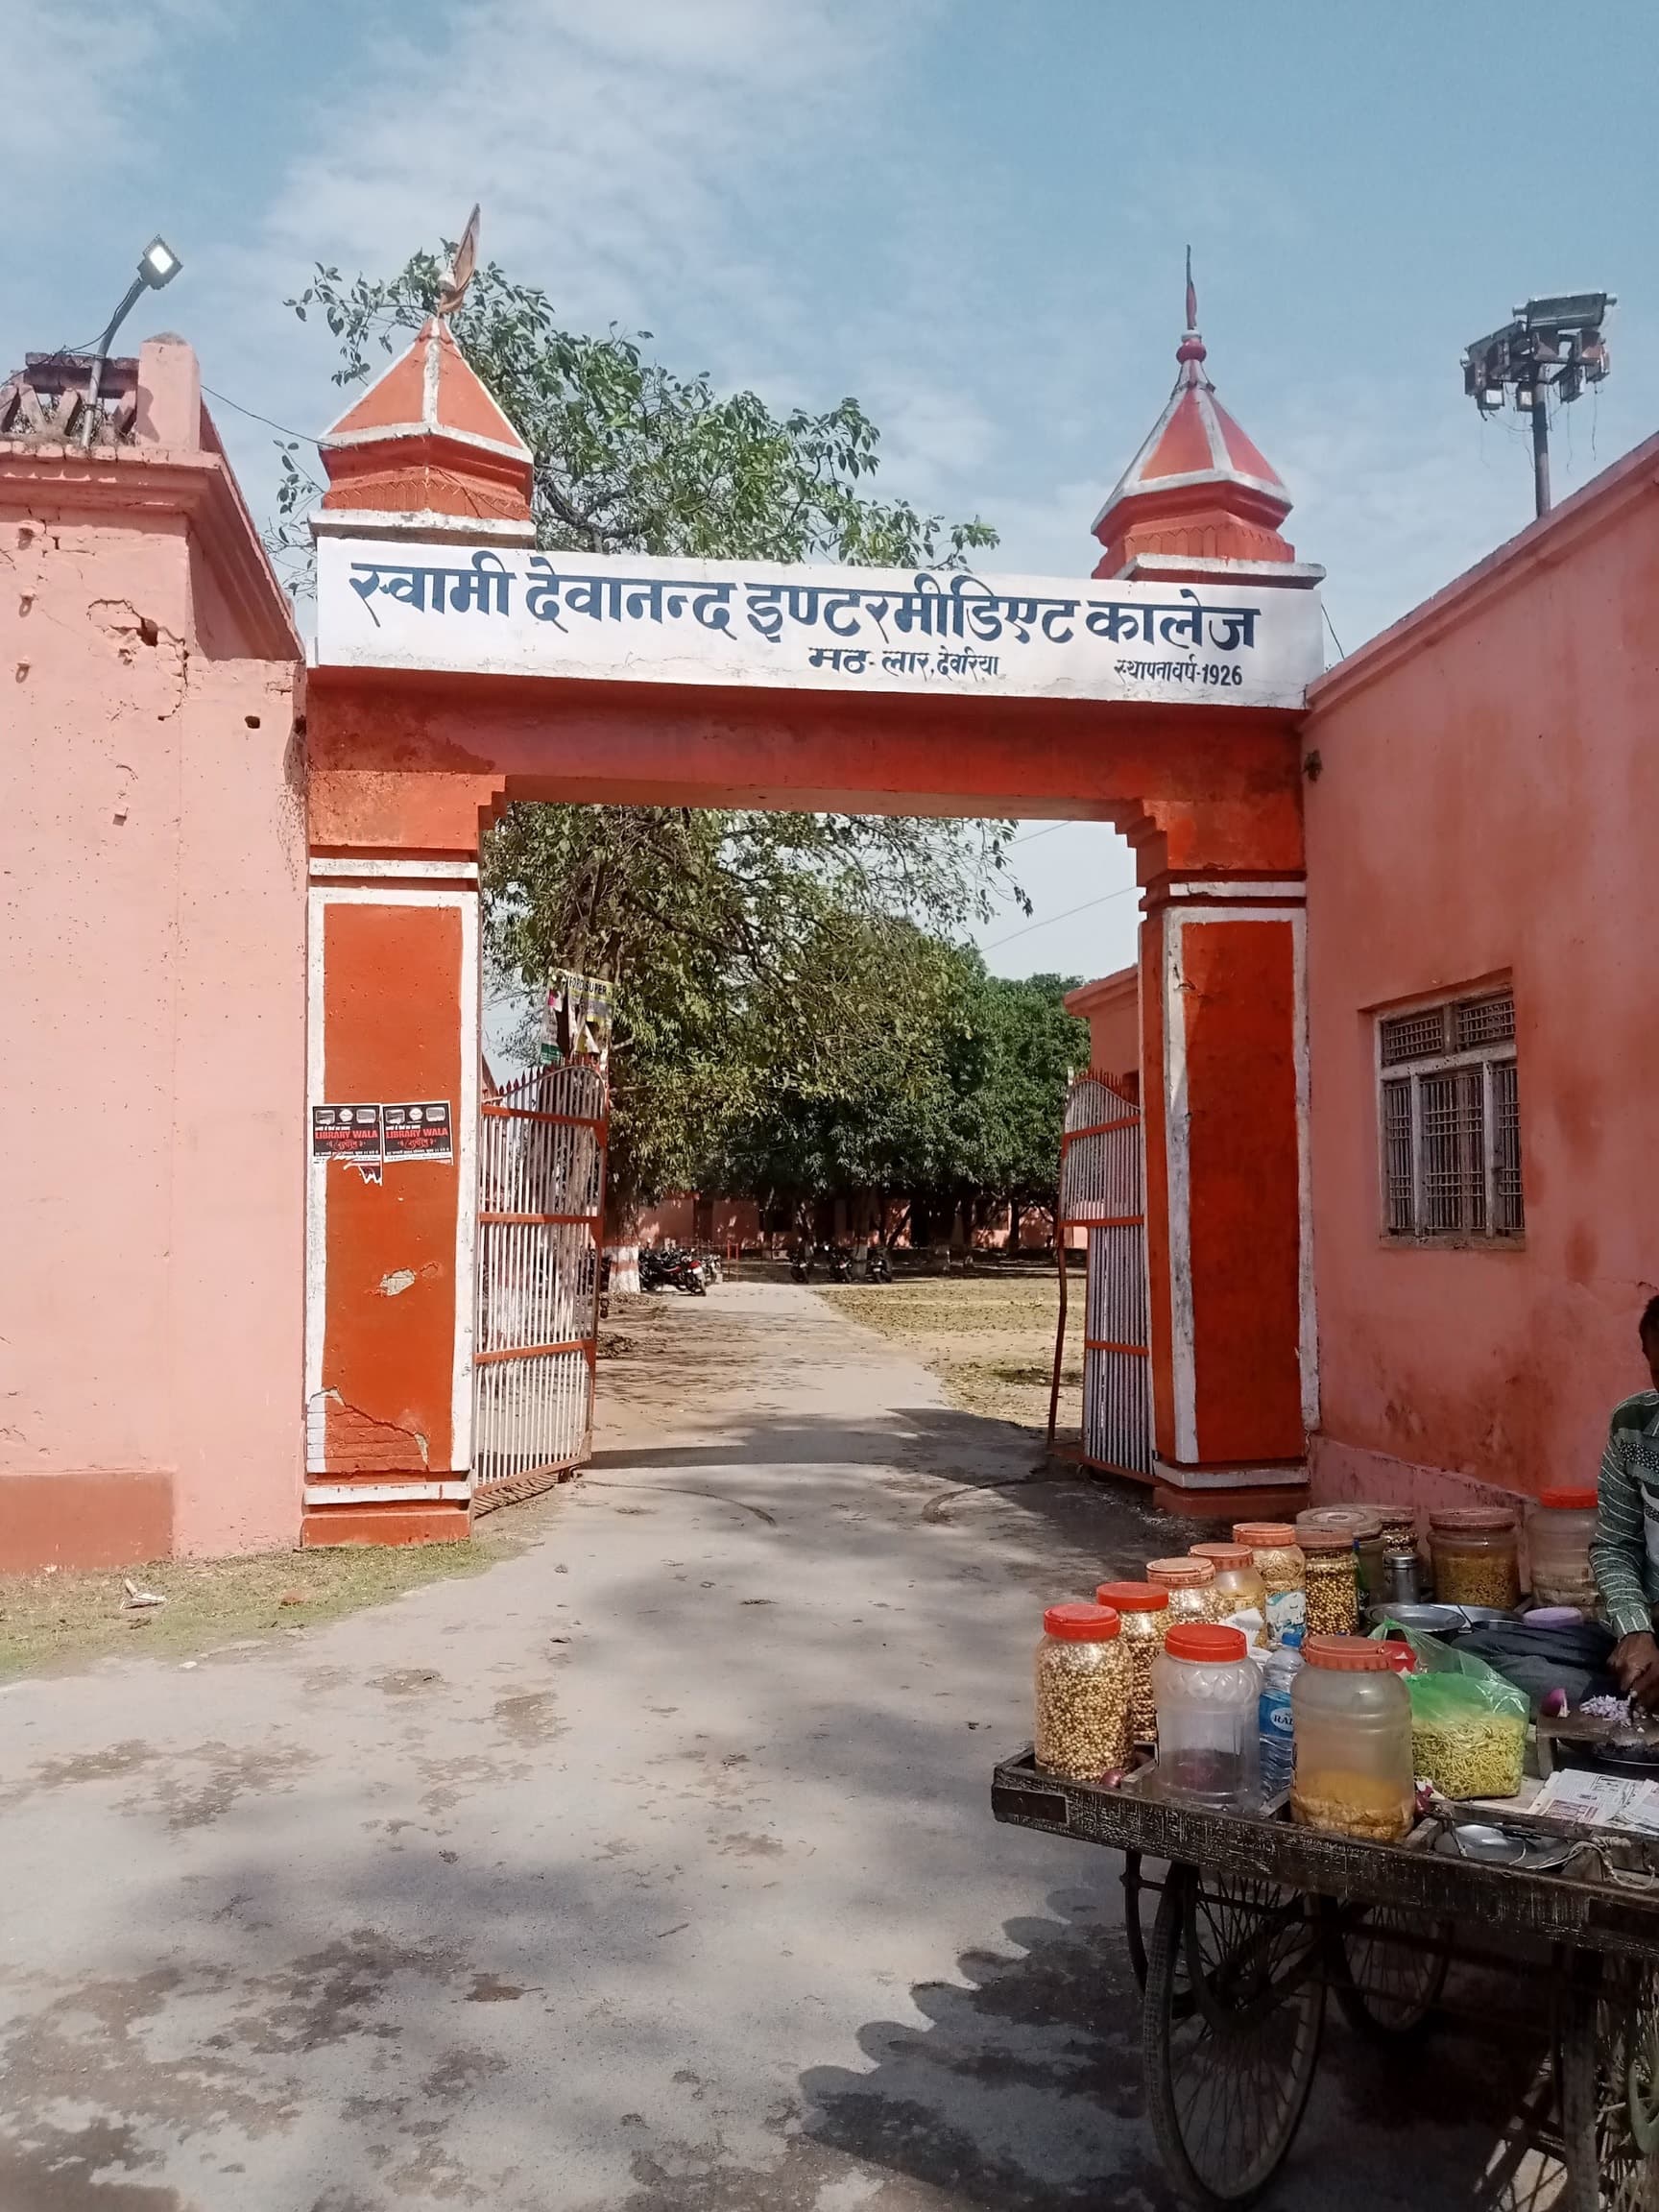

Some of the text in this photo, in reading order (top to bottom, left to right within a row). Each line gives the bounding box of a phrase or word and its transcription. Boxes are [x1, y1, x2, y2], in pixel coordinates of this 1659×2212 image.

[349, 550, 517, 628] स्वामी
[525, 557, 736, 640] देवानन्द
[1086, 589, 1262, 651] कालेज
[315, 1130, 378, 1140] LIBRARY WALA
[385, 1130, 421, 1139] LIBRARY
[422, 1127, 448, 1137] WALA
